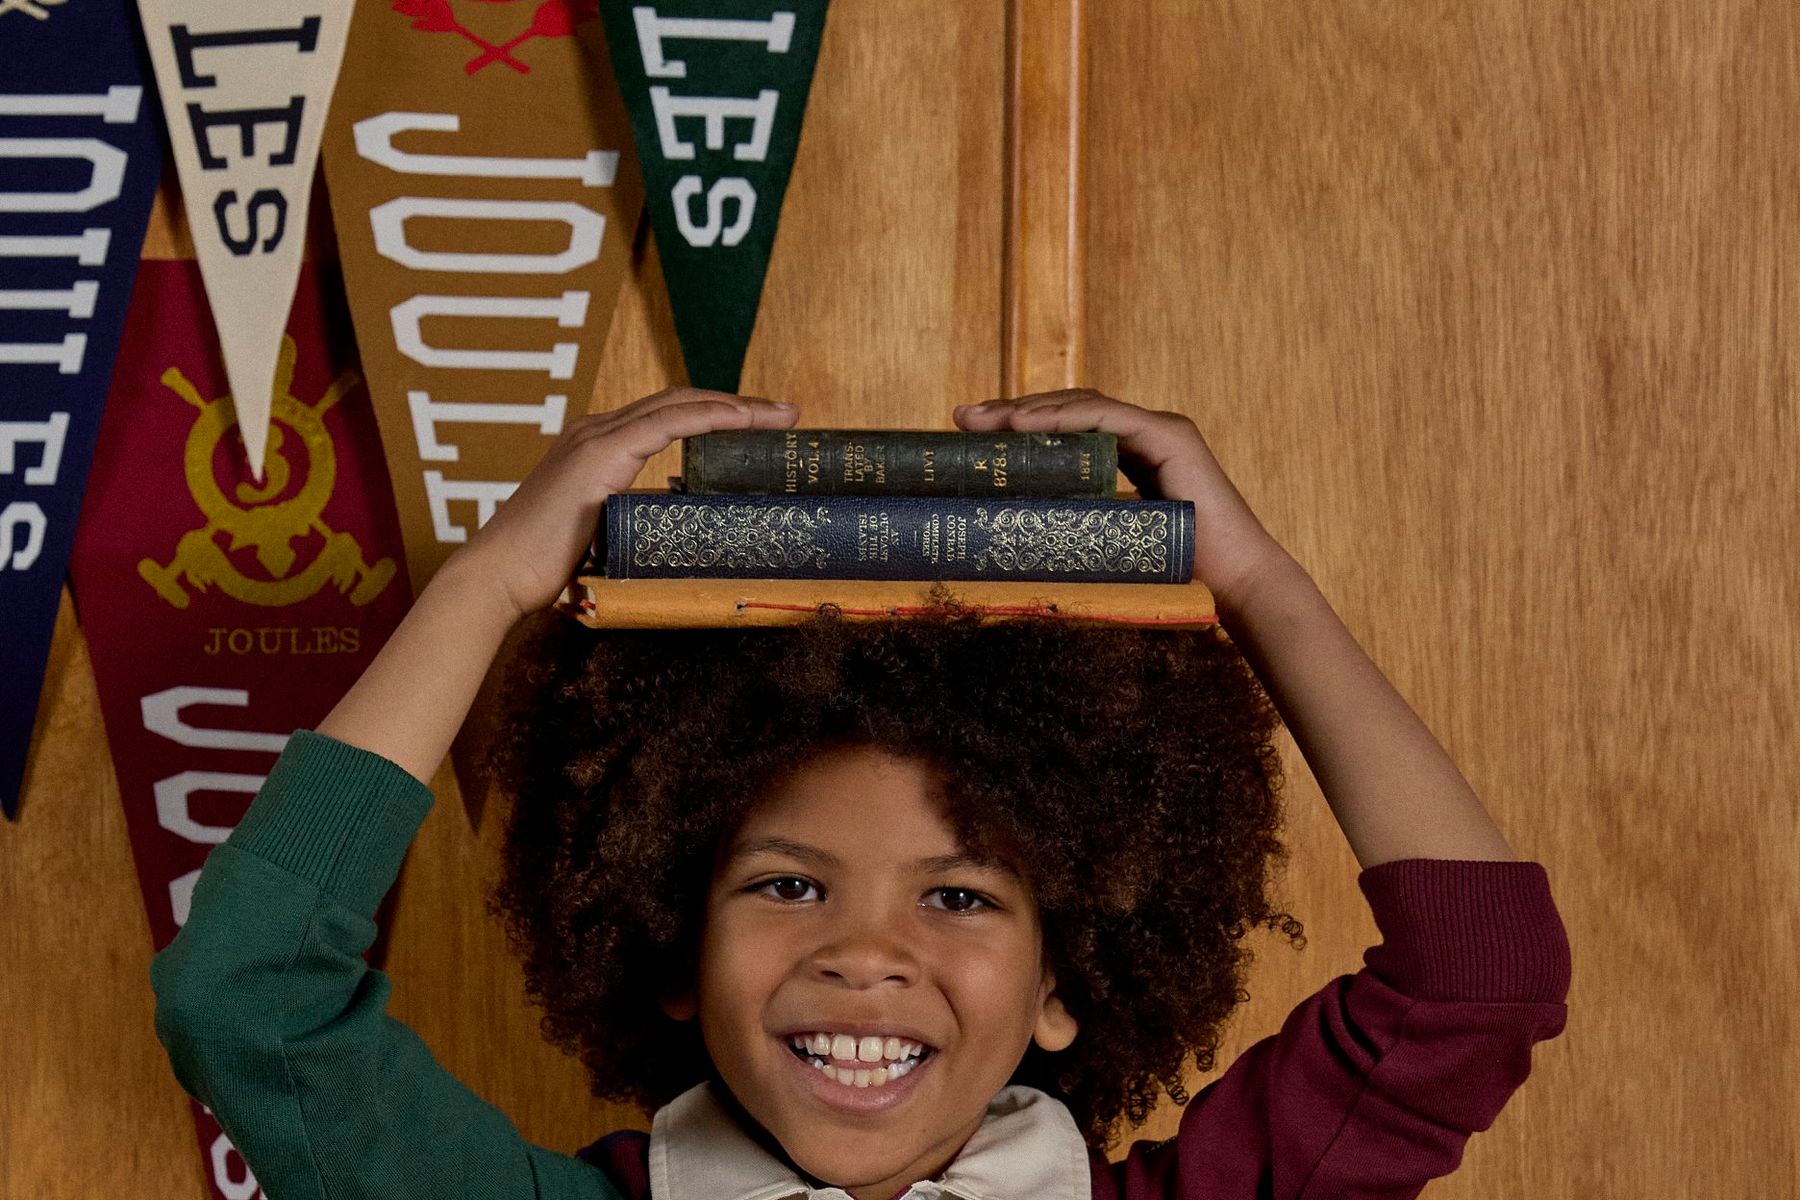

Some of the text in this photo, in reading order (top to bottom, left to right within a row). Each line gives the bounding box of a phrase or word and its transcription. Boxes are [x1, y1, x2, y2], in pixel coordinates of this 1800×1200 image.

[785, 432, 798, 493] HISTORY
[855, 445, 865, 482] LATED
[924, 450, 935, 482] LIVY
[975, 459, 988, 471] R
[992, 442, 1008, 488] 878.4
[858, 512, 869, 562] ISLANDS
[869, 514, 879, 560] OF THE
[879, 511, 890, 563] OUTCAST
[922, 521, 931, 558] WORKS
[946, 514, 957, 563] CONRAD
[957, 515, 967, 561] JOSEPH
[203, 627, 361, 656] JOULES
